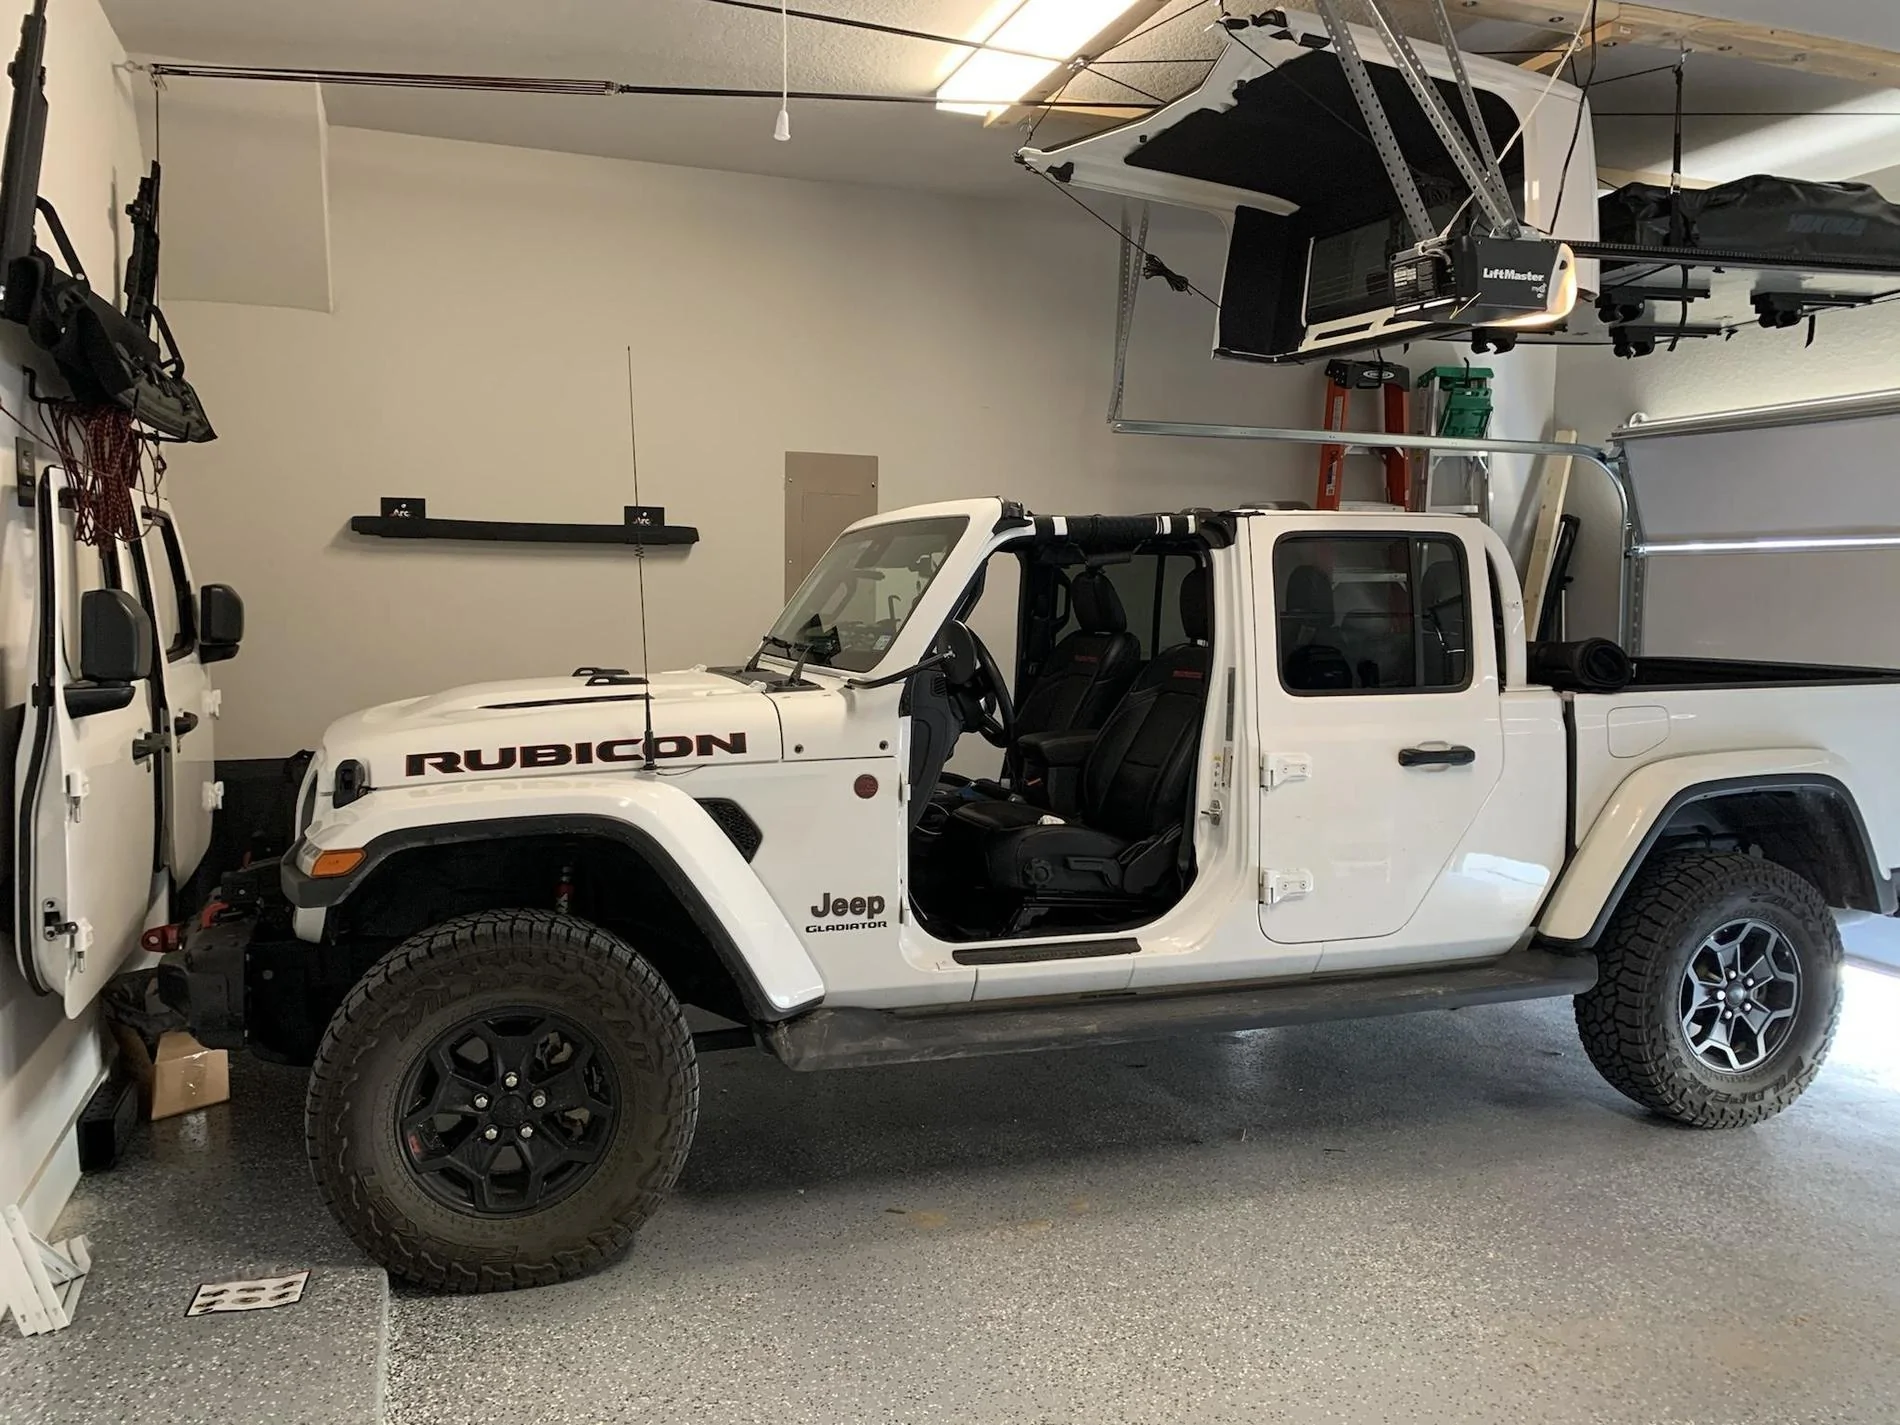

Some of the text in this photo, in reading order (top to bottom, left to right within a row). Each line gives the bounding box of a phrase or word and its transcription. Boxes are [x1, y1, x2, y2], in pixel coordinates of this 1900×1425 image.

[1483, 267, 1544, 281] LiftMaster
[405, 732, 747, 777] RUBICON
[811, 892, 885, 919] Jeep
[805, 921, 887, 933] GLADIATOR
